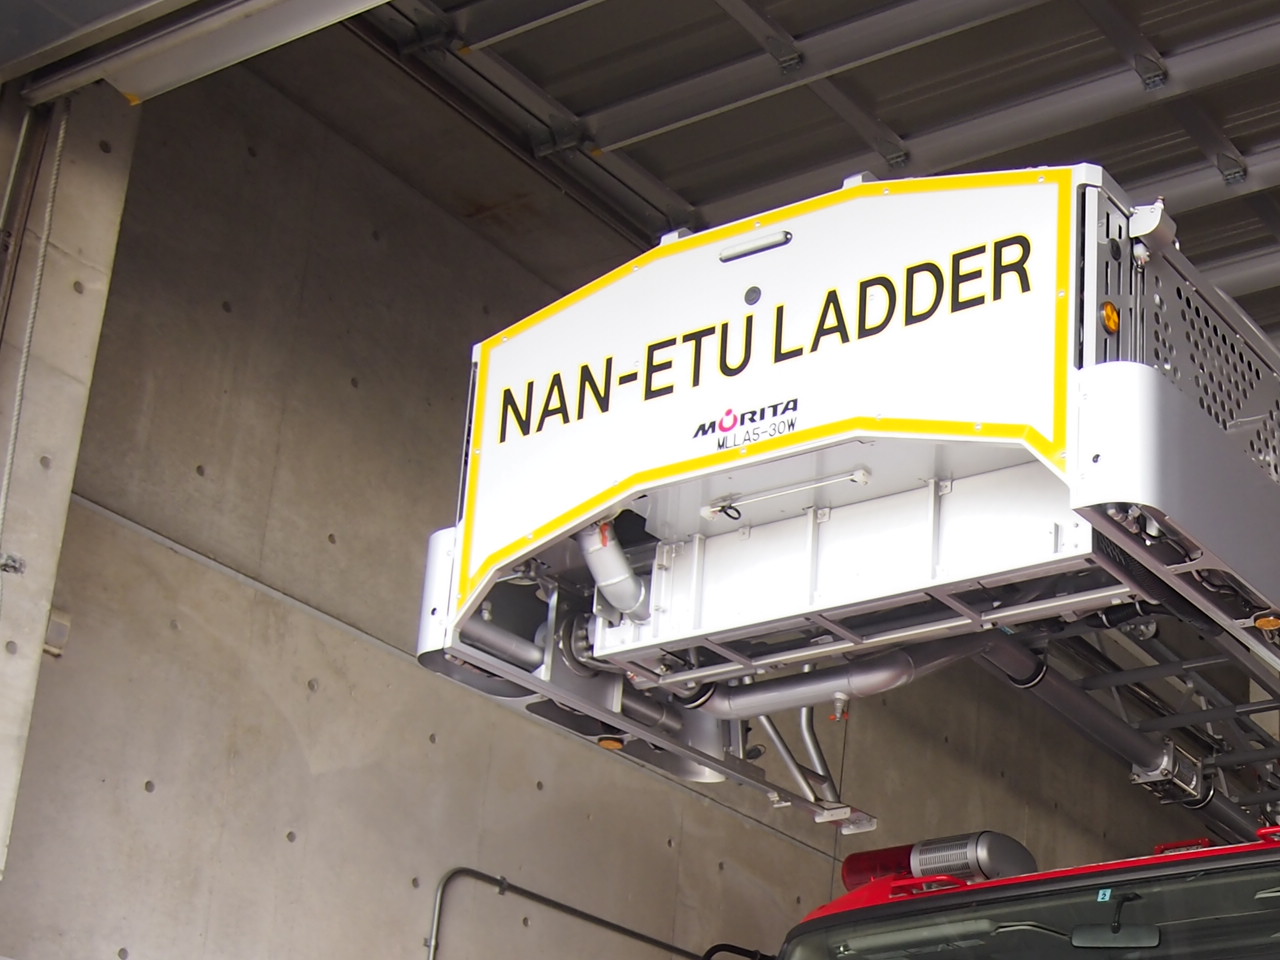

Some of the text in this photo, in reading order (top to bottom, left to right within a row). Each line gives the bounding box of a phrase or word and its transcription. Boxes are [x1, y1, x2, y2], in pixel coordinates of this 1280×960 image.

[498, 234, 1033, 443] NAN-ETU LADDER
[692, 398, 798, 438] MORITA
